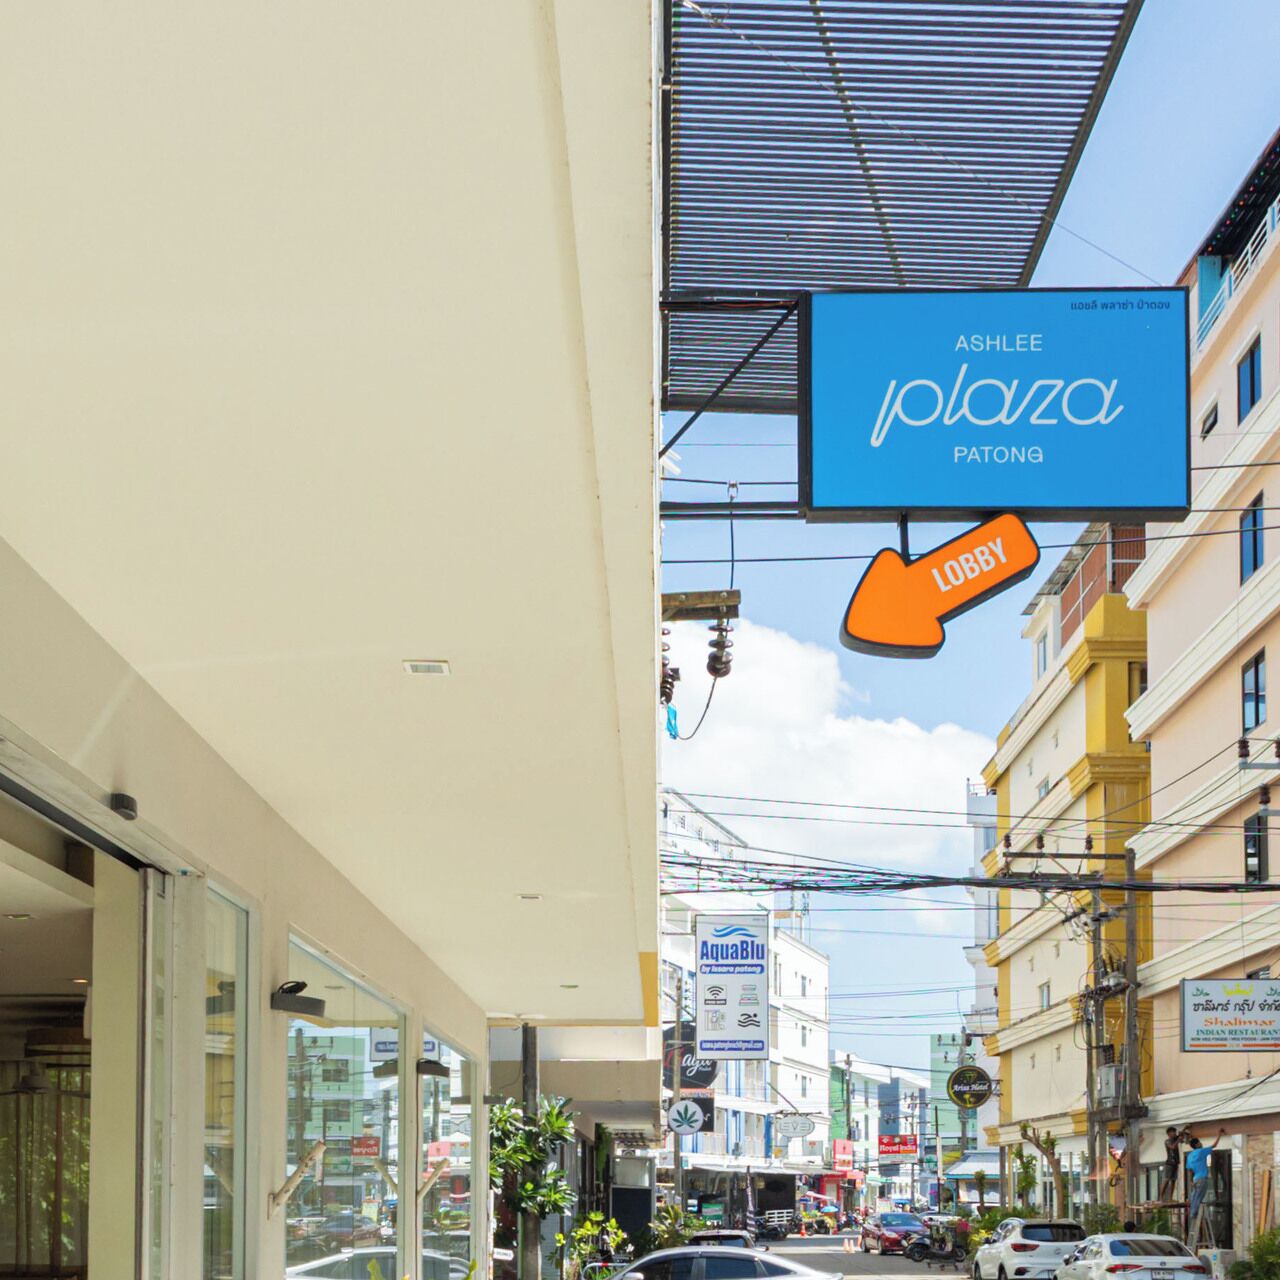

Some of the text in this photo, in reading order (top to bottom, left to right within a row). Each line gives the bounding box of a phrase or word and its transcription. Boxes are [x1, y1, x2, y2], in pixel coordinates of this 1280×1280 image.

[954, 334, 1043, 352] ASHLEE
[870, 363, 1124, 448] plaza
[953, 446, 1044, 464] PATONG
[930, 536, 1008, 593] LOBBY
[700, 940, 765, 962] AquaBlu
[1203, 1017, 1277, 1028] Shalimar
[1196, 1029, 1227, 1037] INDIAN
